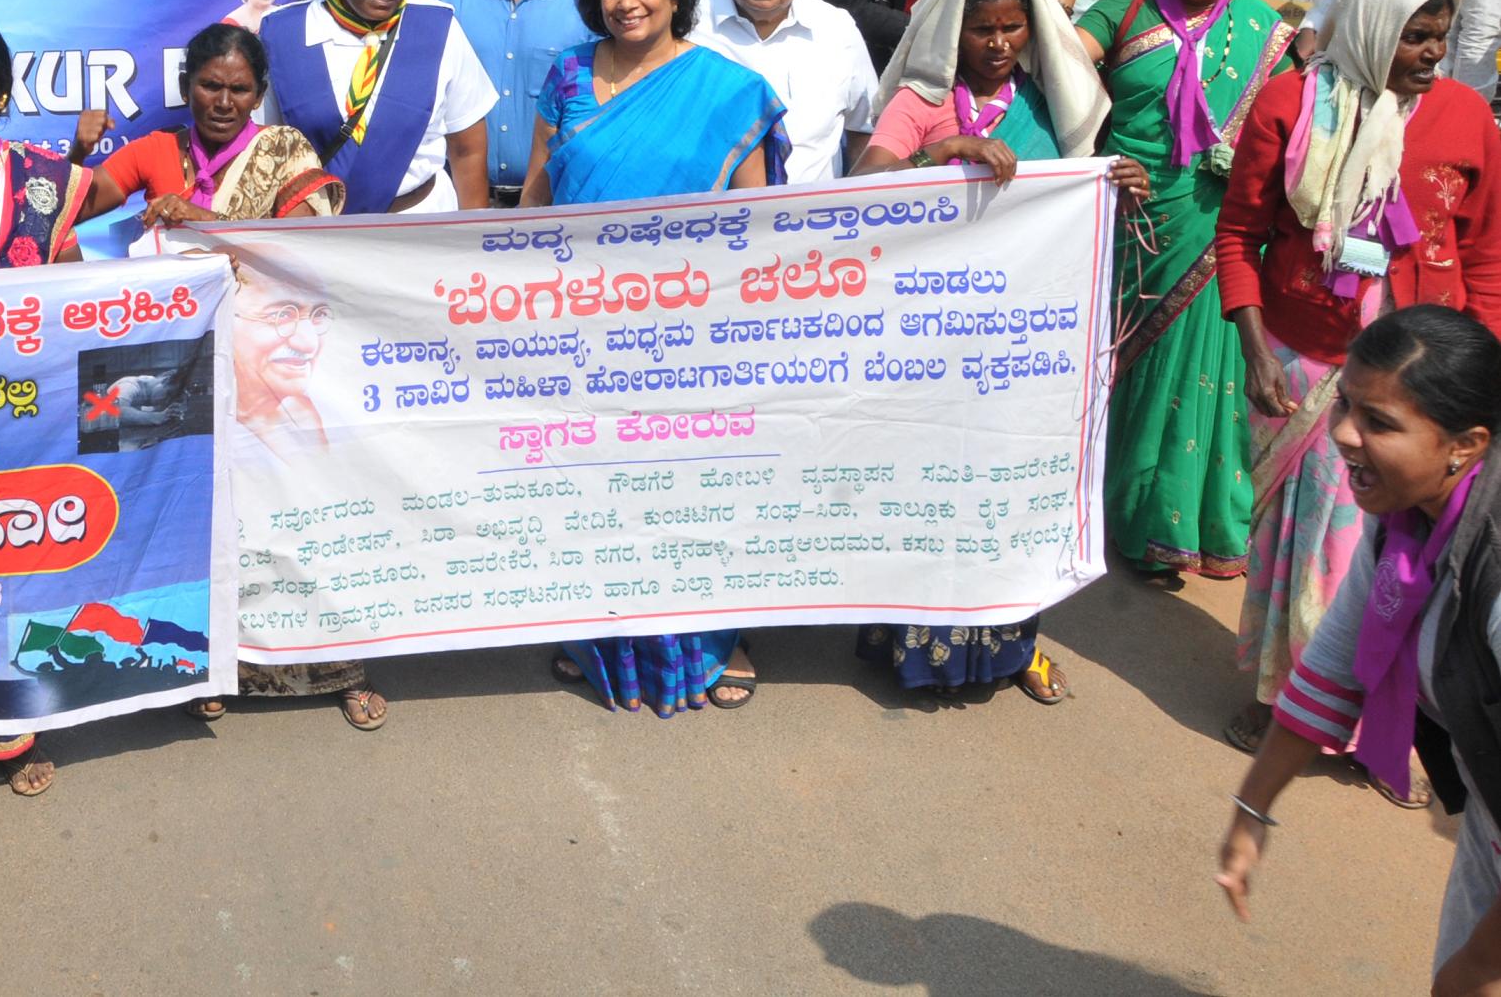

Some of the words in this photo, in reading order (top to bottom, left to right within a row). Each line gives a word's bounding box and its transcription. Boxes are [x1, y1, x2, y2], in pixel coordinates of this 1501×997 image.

[482, 221, 574, 263] ಮದ್ಯ
[596, 207, 751, 252] ನಿಷೇಧಕ್ಕೆ
[773, 195, 959, 241] ಒತ್ತಾಯಿಸಿ
[894, 263, 1007, 296] ಮಾಡಲು
[62, 284, 200, 338] ಆಗ್ರಹಿಸಿ
[361, 335, 461, 376] ಈಶಾನ್ಯ,
[476, 325, 592, 368] ವಾಯುವ್ಯ,
[605, 317, 696, 363] ಮಧ್ಯಮ
[709, 307, 885, 346] ಕರ್ನಾಟಕದಿಂದ
[900, 298, 1079, 345] ಆಗಮಿಸುತ್ತಿರುವ
[362, 383, 381, 413] 3
[395, 373, 470, 409] ಸಾವಿರ
[484, 372, 572, 401] ಮಹಿಳಾ
[586, 350, 849, 396] ಹೋರಾಟಗಾರ್ತಿಯರಿಗೆ
[864, 349, 947, 384] ಬೆಂಬಲ
[962, 348, 1076, 396] ವ್ಯಕ್ತಪಡಿಸಿ,
[499, 413, 598, 464] ಸ್ವಾಗತ
[616, 404, 756, 445] ಕೋರುವ
[270, 496, 376, 533] ಸರ್ವೋದಯ
[608, 469, 675, 494] ಗೌಡಗೆರೆ
[699, 466, 776, 489] ಹೋಬಳಿ
[801, 462, 895, 495] ವ್ಯವಸ್ಥಾಪನ
[421, 526, 456, 544] ಸಿರಾ
[475, 515, 547, 546] ಅಭಿವೃದ್ಧಿ
[564, 508, 624, 531] ವೇದಿಕೆ,
[643, 503, 736, 526] ಕುಂಚಿಟಿಗರ
[879, 499, 957, 527] ತಾಲ್ಲೂಕು
[978, 497, 1010, 530] ರೈತ
[1027, 488, 1075, 514] ಸಂಘ,
[549, 549, 584, 567] ಸಿರಾ
[594, 542, 641, 565] ನಗರ,
[902, 533, 945, 554] ಕಸಬ
[955, 534, 1001, 562] ಮತ್ತು
[318, 599, 404, 633] ಗ್ರಾಮಸ್ಥರು,
[413, 590, 473, 614] ಜನಪರ
[483, 579, 593, 609] ಸಂಘಟನೆಗಳು
[603, 577, 660, 598] ಹಾಗೂ
[671, 574, 714, 601] ಎಲ್ಲಾ
